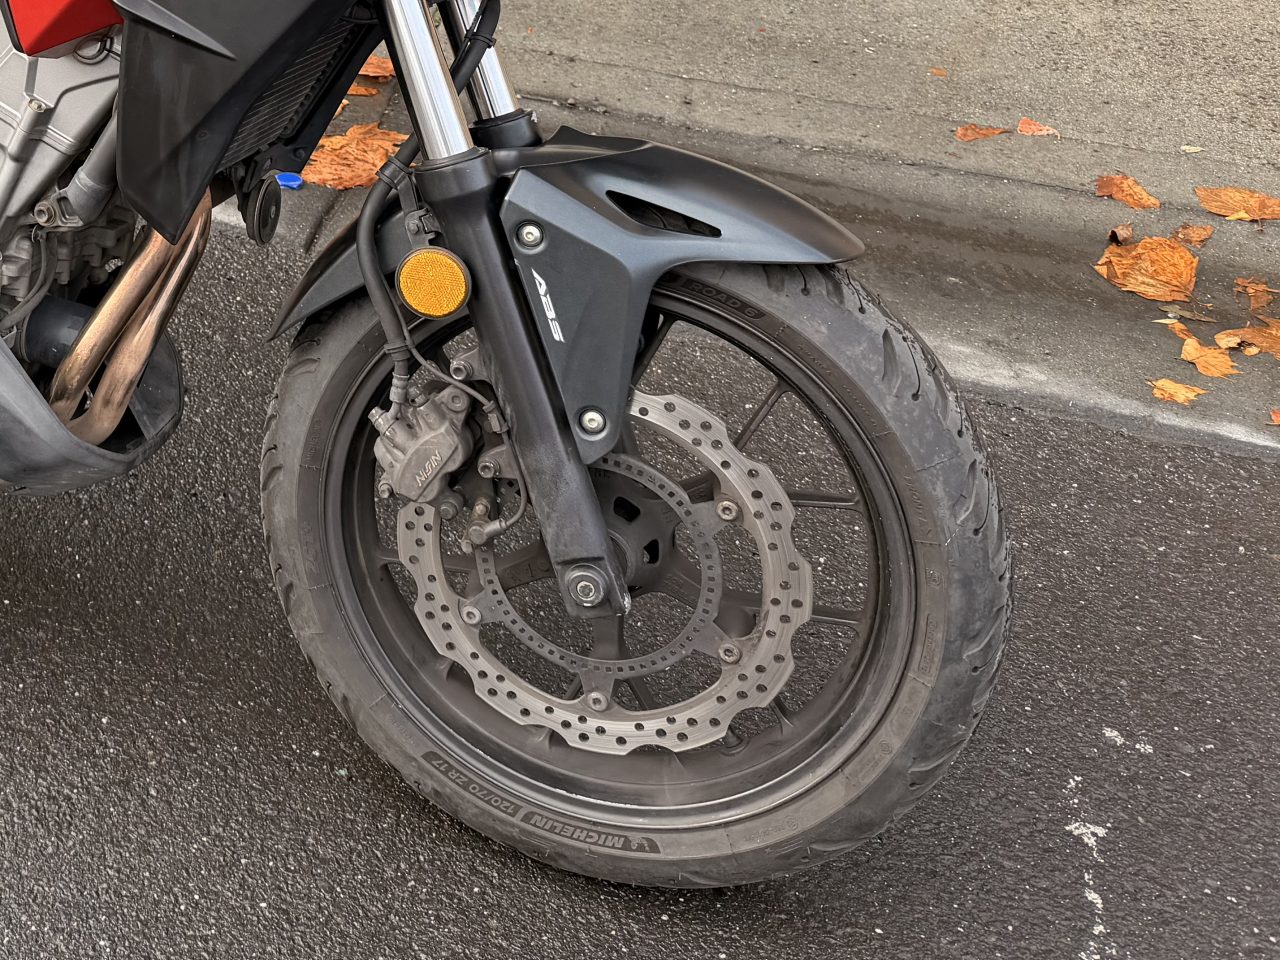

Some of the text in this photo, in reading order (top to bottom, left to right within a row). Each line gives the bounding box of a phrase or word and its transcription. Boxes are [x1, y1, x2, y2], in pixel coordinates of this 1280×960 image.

[531, 267, 566, 344] ABS
[415, 449, 442, 487] NISSIN
[431, 756, 626, 848] MICHELIN 120/70 ZR 17
